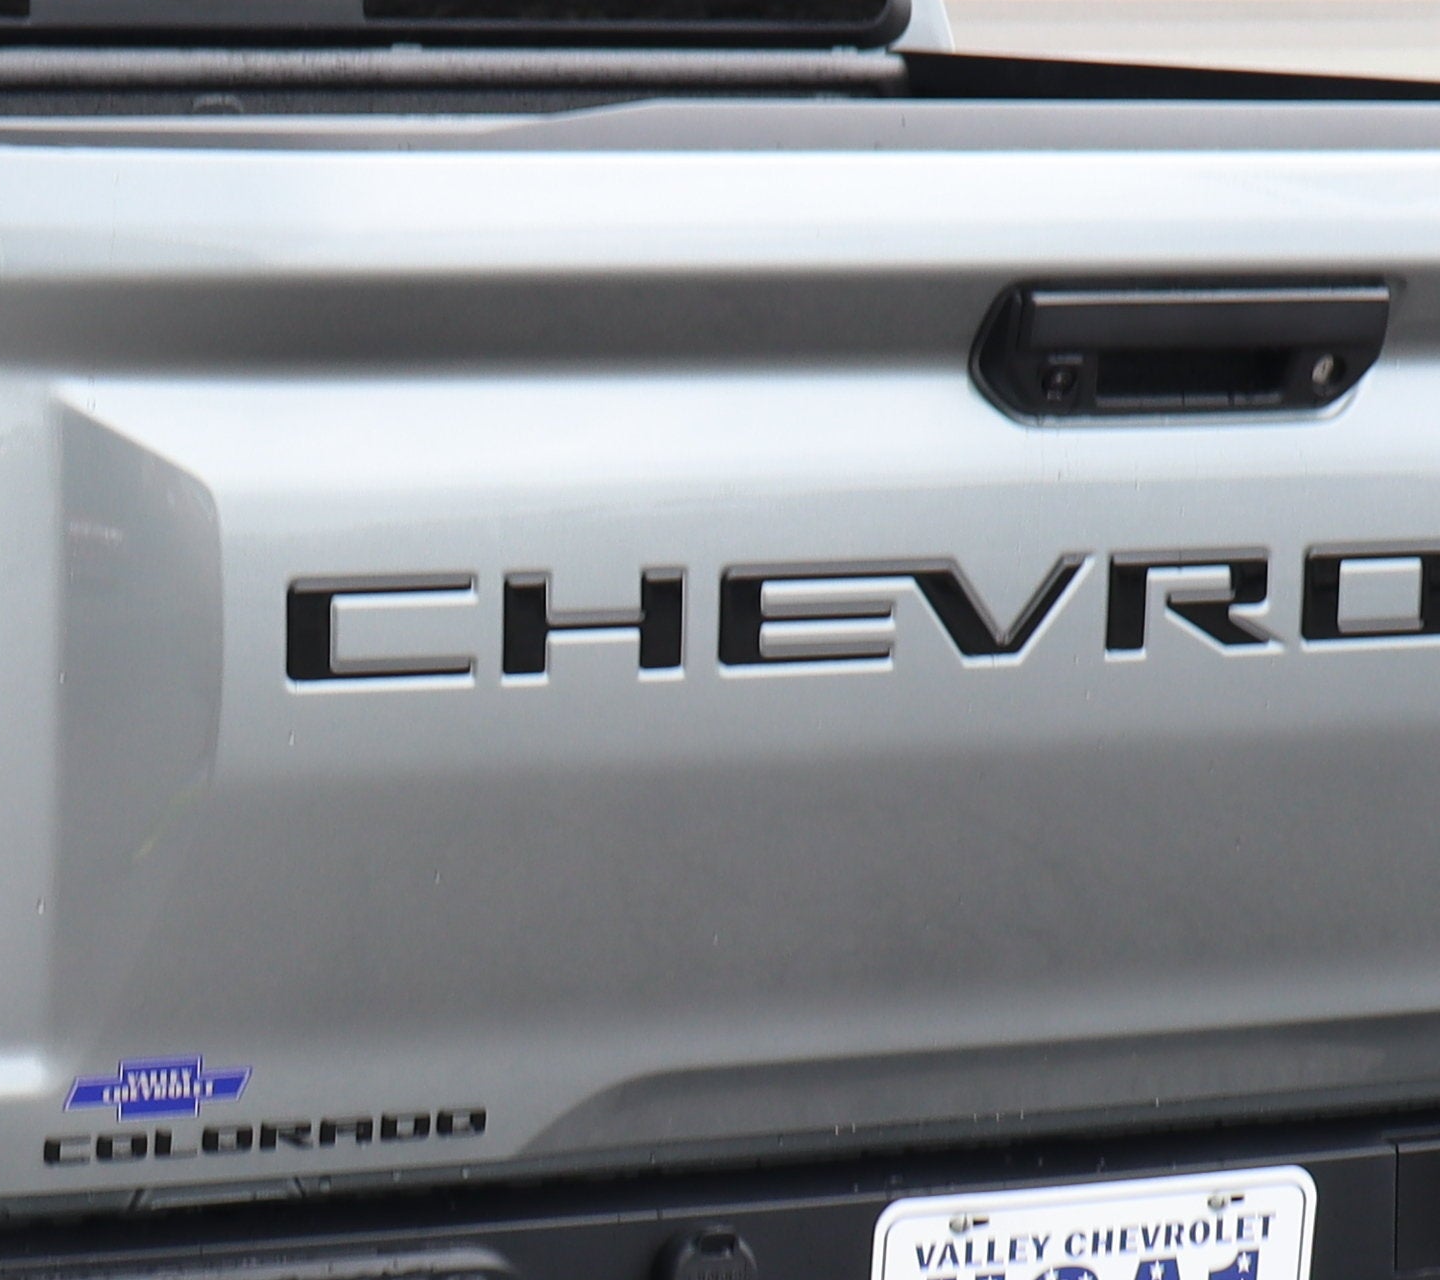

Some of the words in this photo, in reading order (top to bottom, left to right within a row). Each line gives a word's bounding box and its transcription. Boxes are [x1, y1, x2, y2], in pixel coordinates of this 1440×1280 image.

[43, 1107, 487, 1166] COLORADO
[915, 1234, 1051, 1271] VALLEY
[1064, 1212, 1276, 1258] CHEVROLET
